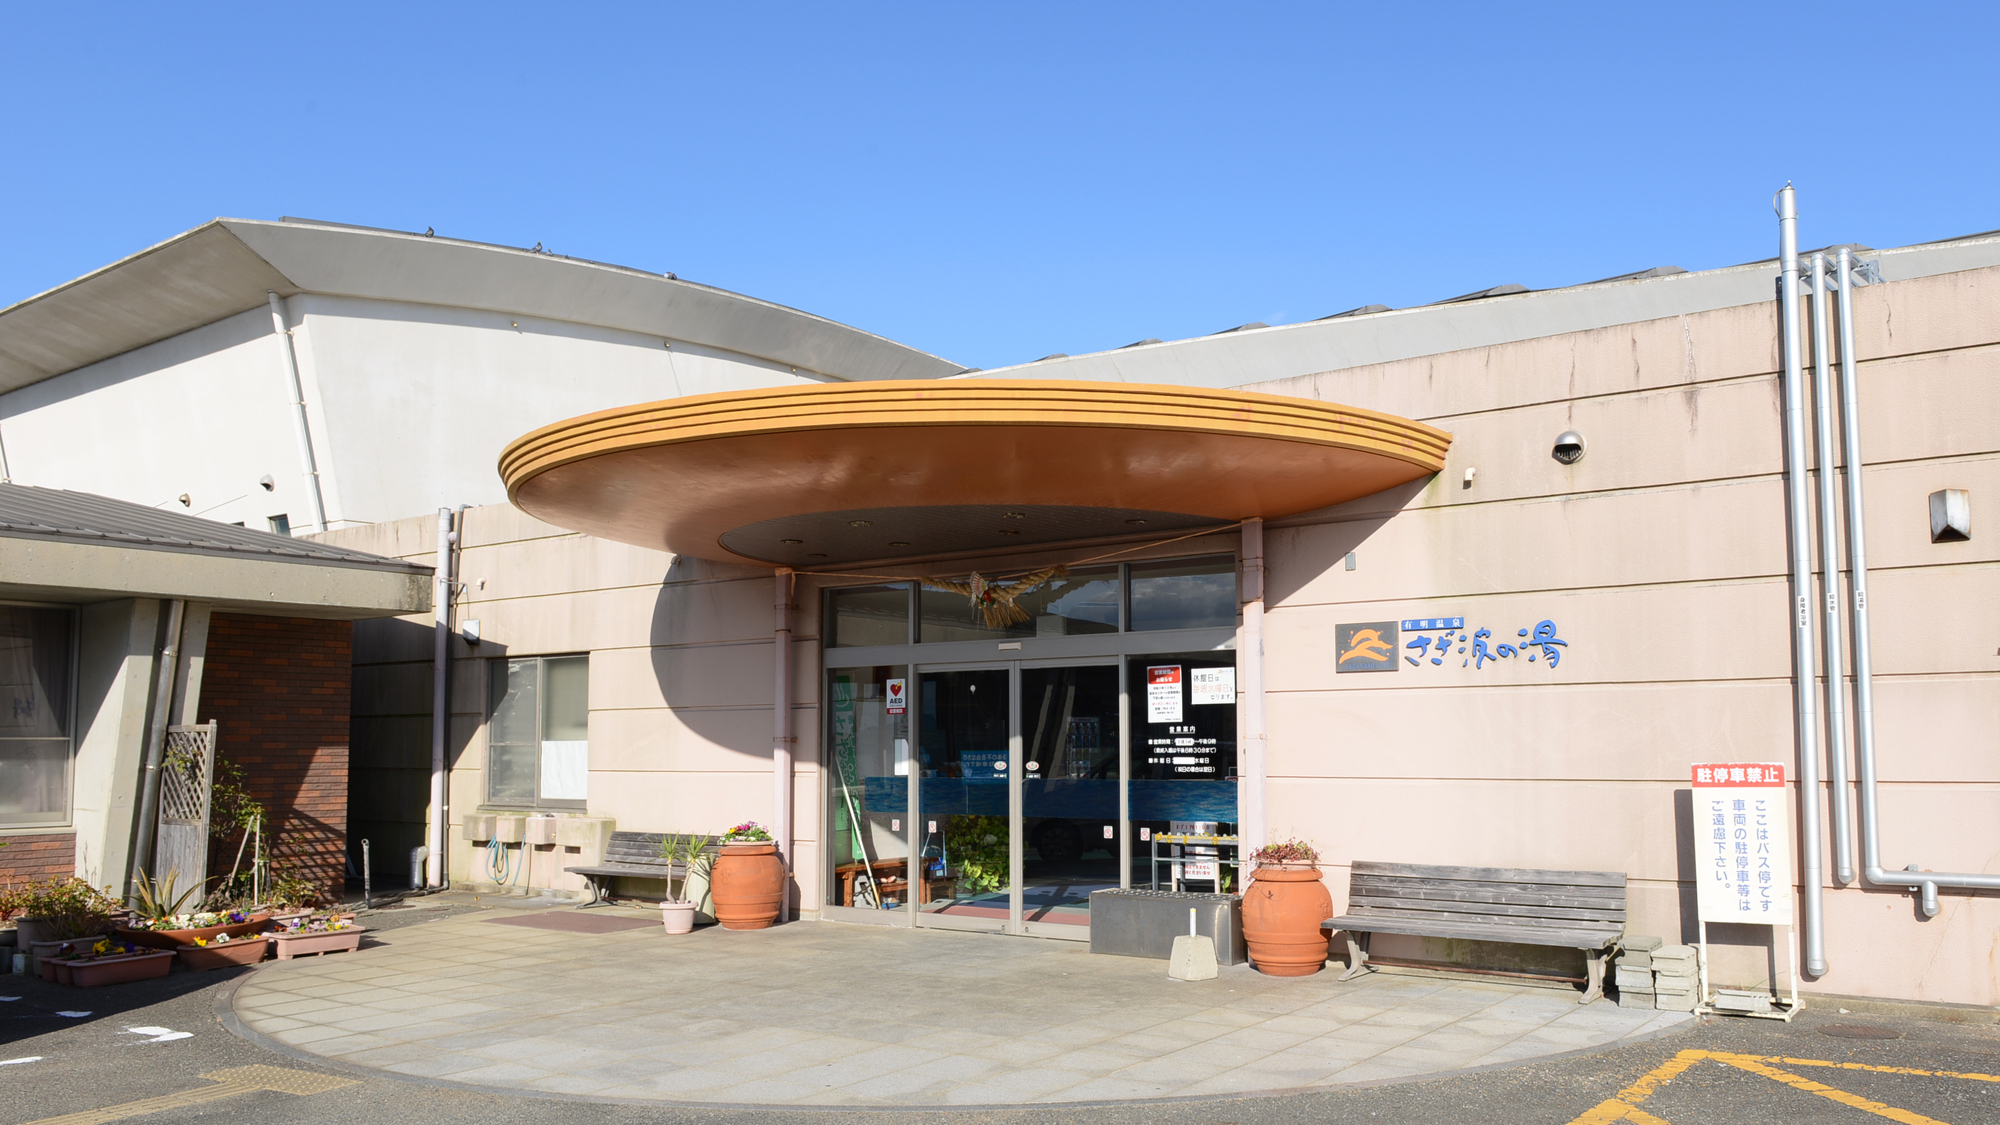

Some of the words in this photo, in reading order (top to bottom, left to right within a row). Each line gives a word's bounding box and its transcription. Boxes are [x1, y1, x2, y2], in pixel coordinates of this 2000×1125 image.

[1404, 618, 1461, 630] 有明温泉
[1404, 619, 1569, 669] さざ波の湯
[1193, 673, 1220, 682] 休館日は
[1193, 684, 1233, 693] 毎週水曜日と
[1696, 767, 1780, 783] 駐停車禁止
[1711, 800, 1731, 889] ご遠慮下さい。
[1732, 799, 1751, 912] 車両の駐停車等は
[1755, 799, 1773, 912] ここはバス停です
